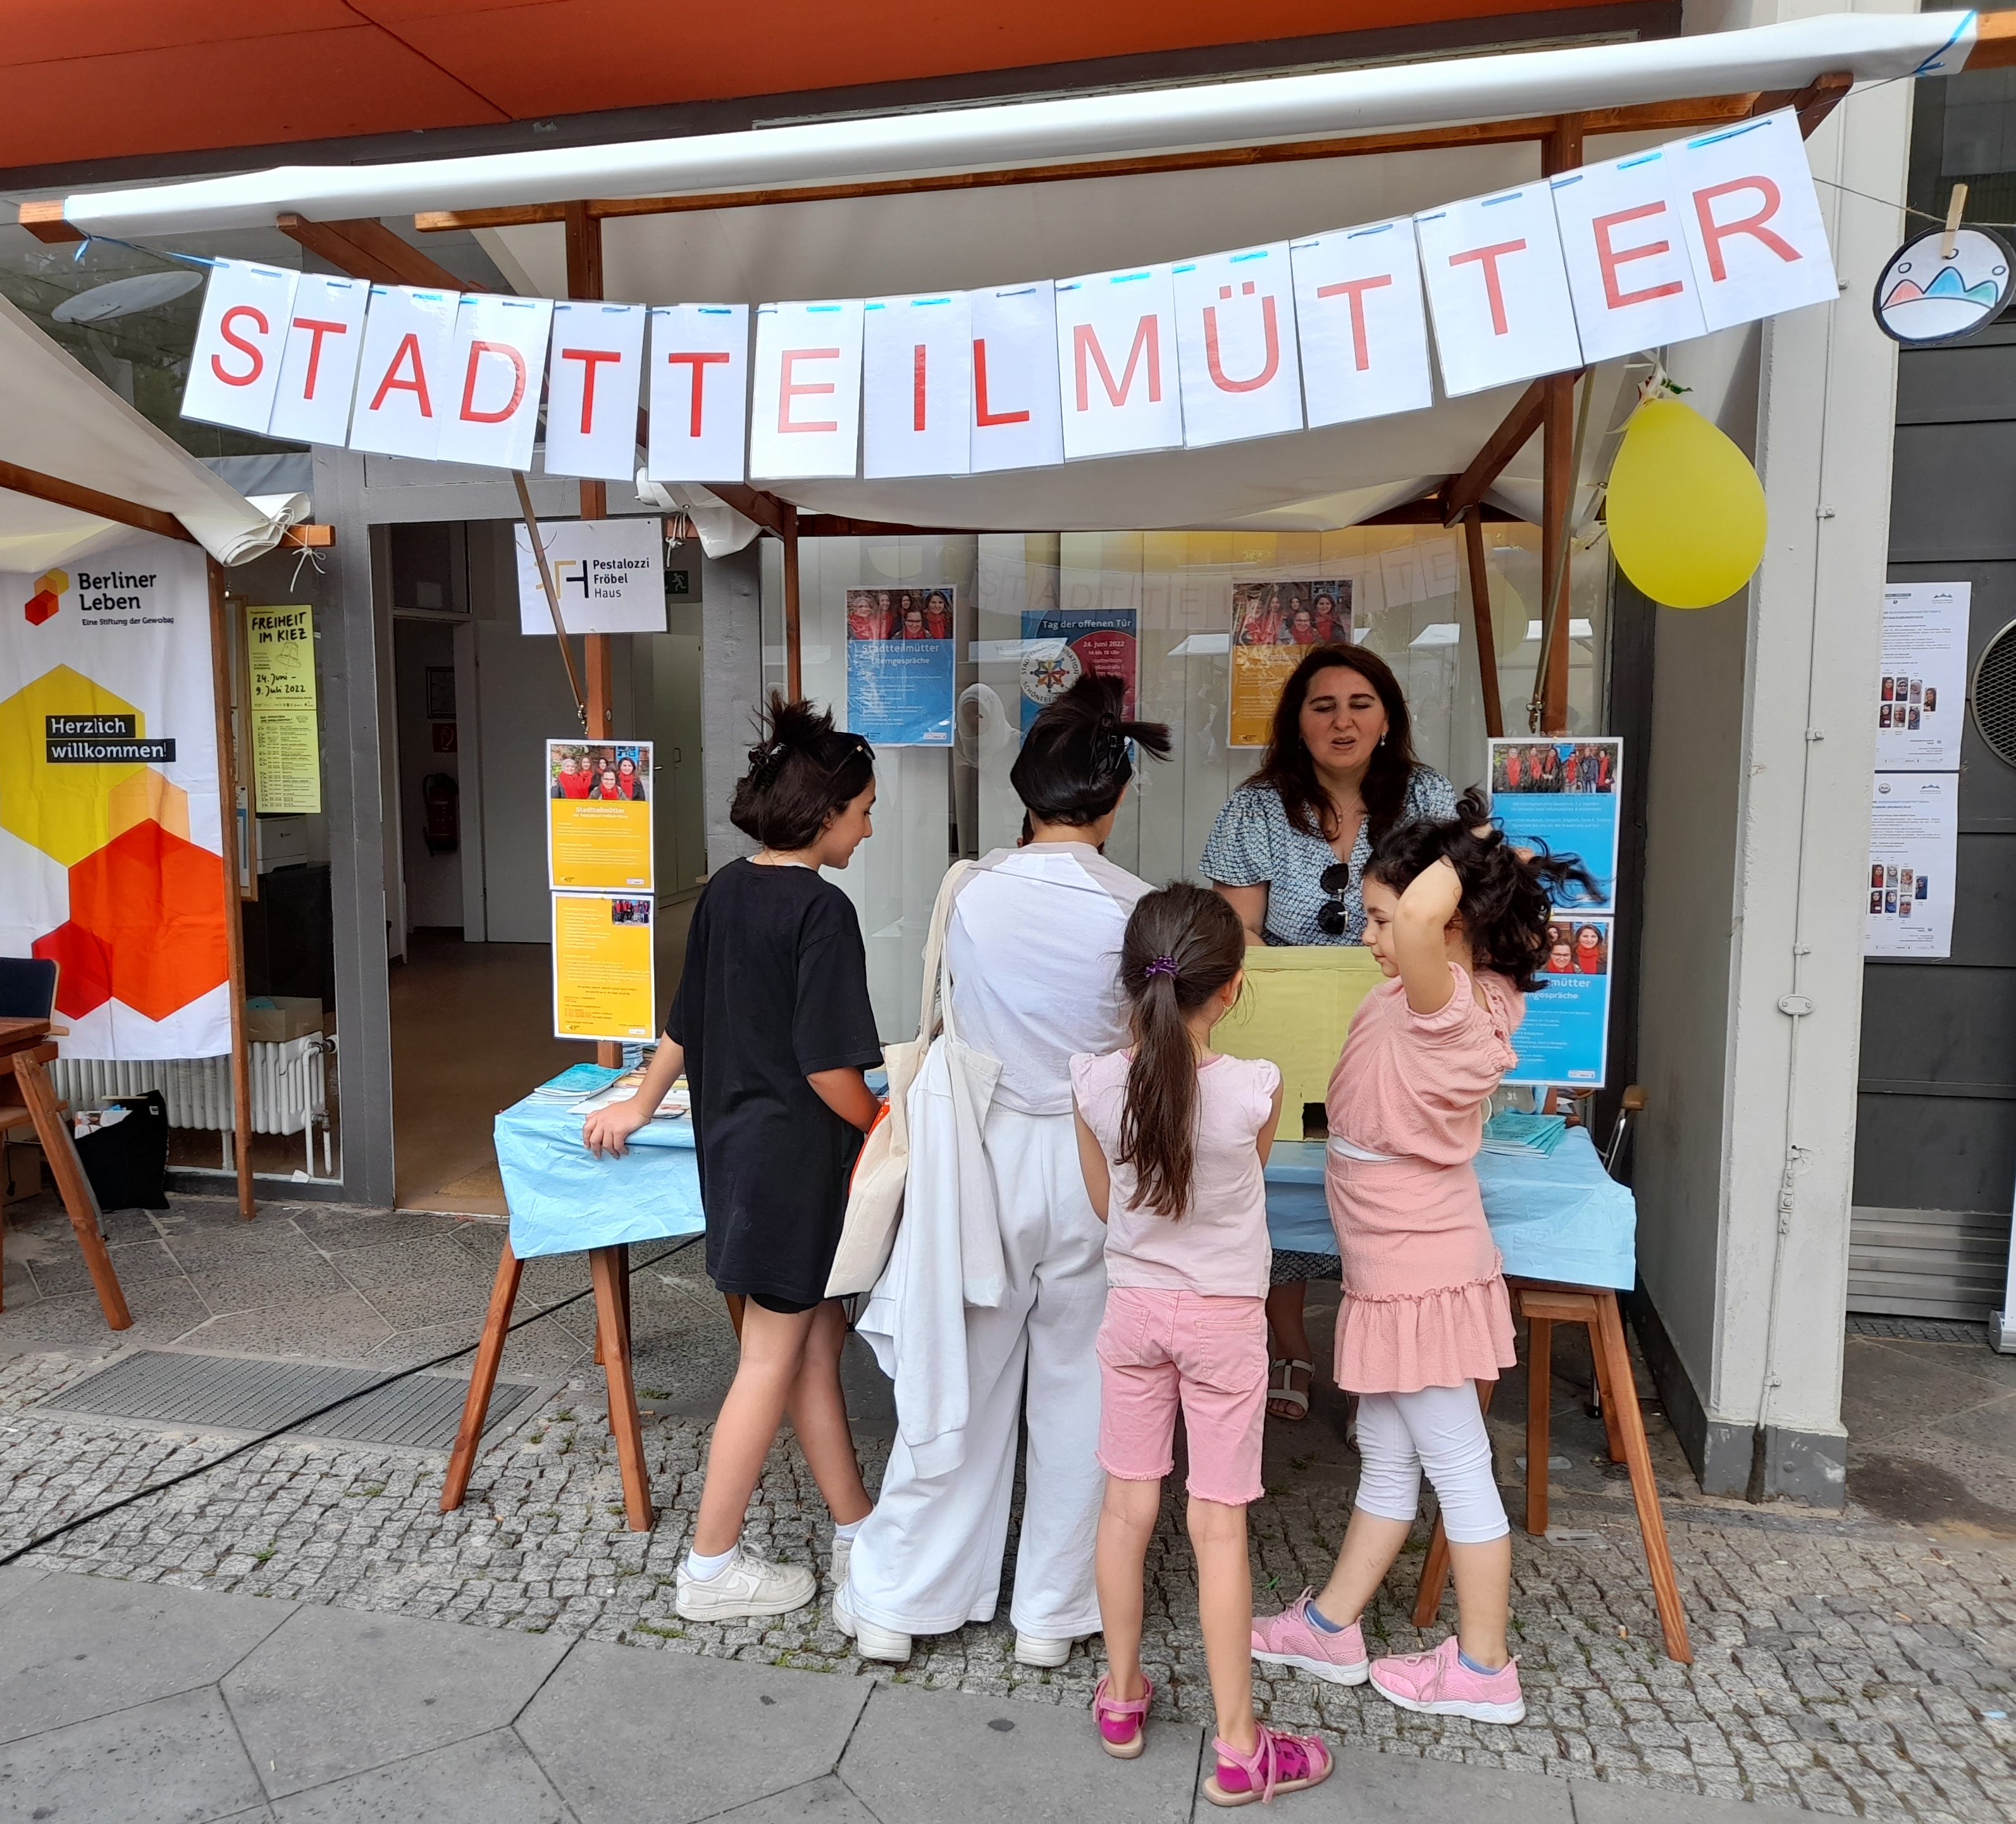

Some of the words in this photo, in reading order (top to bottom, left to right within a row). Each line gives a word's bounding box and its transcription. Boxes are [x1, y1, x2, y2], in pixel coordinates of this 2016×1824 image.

[211, 177, 1798, 438] STADTTEILMÜTTER
[593, 557, 650, 569] Pestalozzi
[78, 571, 156, 590] Berliner
[594, 573, 628, 584] Fröbel
[595, 588, 622, 599] Haus
[79, 593, 141, 611] Leben
[252, 612, 307, 631] FREIHEIT
[1042, 621, 1059, 630] Tag
[1078, 619, 1113, 628] offenen
[1115, 619, 1132, 627] Tür
[259, 632, 272, 643] IM
[278, 628, 307, 642] KIEZ
[862, 643, 940, 653] Stadtteilmütter
[256, 674, 269, 683] 24.
[270, 673, 288, 685] Juni
[256, 686, 264, 695] 9.
[265, 685, 282, 697] Juli
[285, 685, 306, 693] 2022
[51, 717, 127, 733] Herzlich
[51, 741, 167, 758] willkommen!
